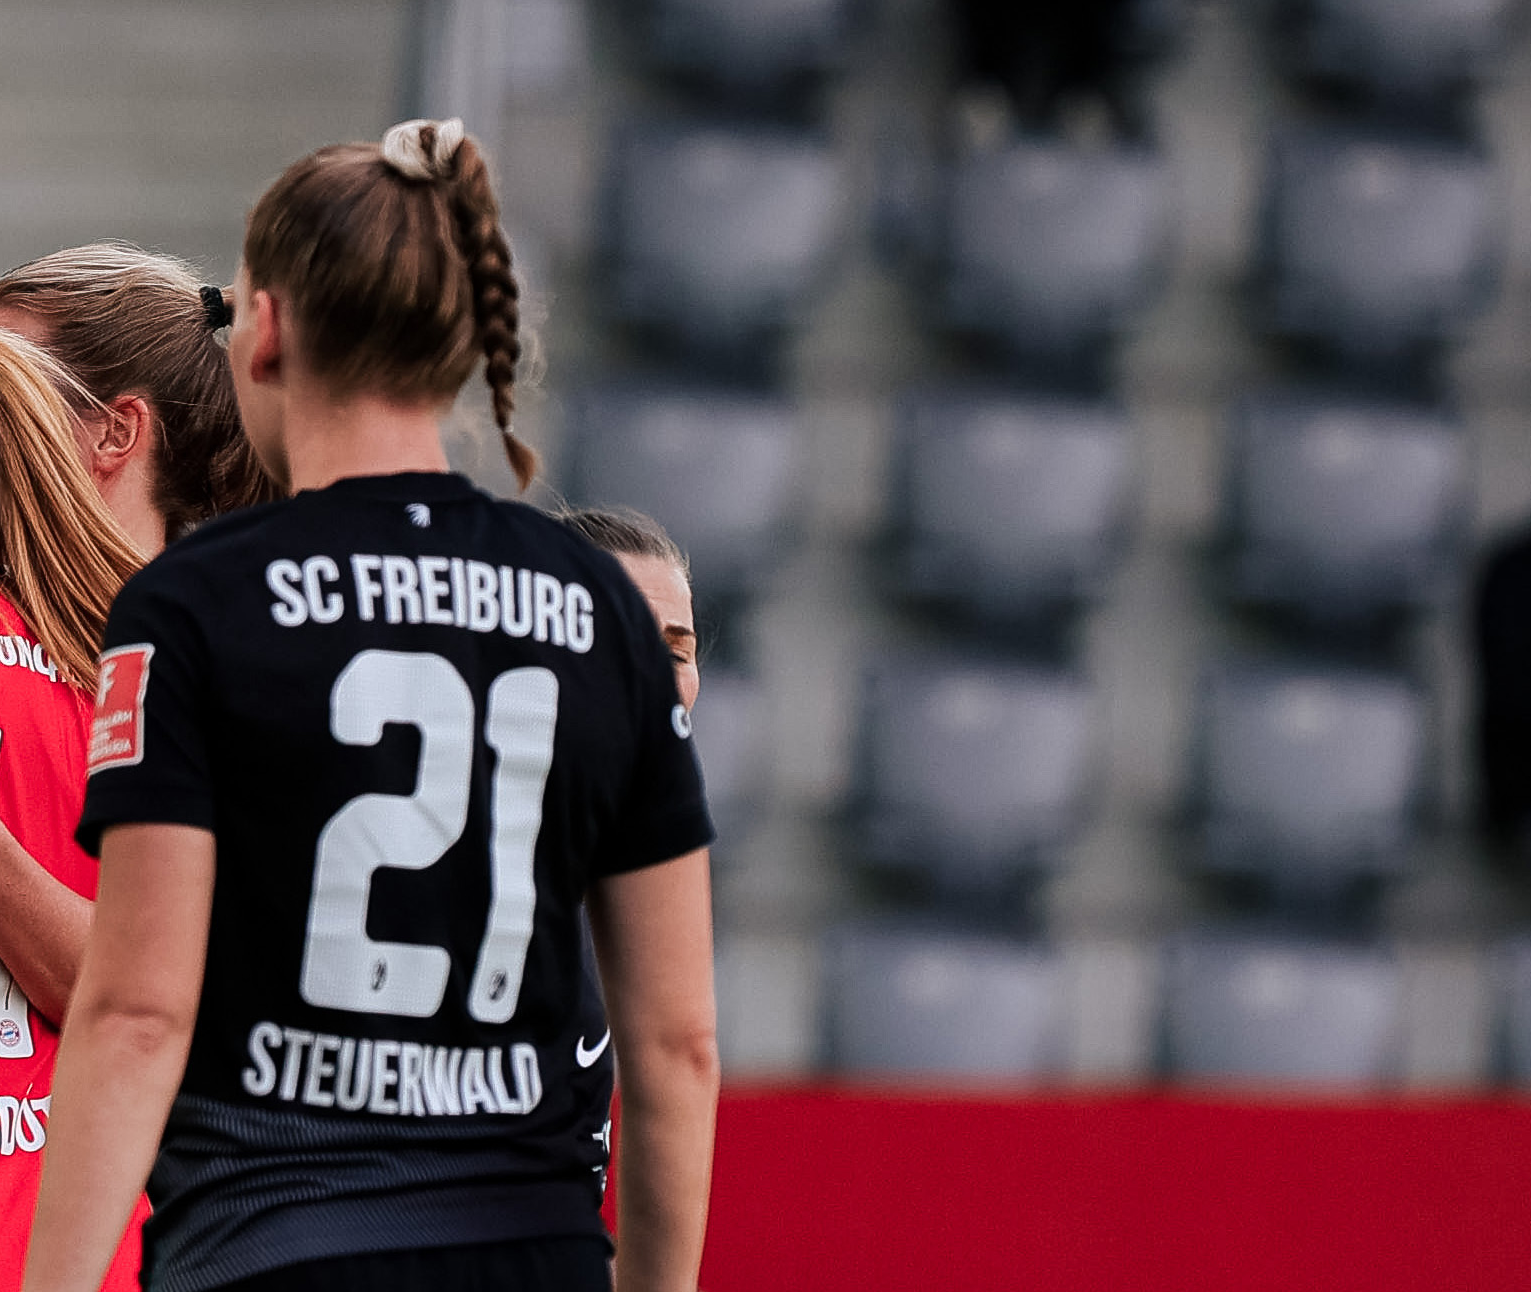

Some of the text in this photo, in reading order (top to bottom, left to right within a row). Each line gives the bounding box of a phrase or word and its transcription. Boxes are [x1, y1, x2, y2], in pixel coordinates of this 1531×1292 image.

[264, 552, 595, 654] SC FREIBURG
[298, 648, 560, 1024] 21
[241, 1020, 544, 1117] STEUERWALD
